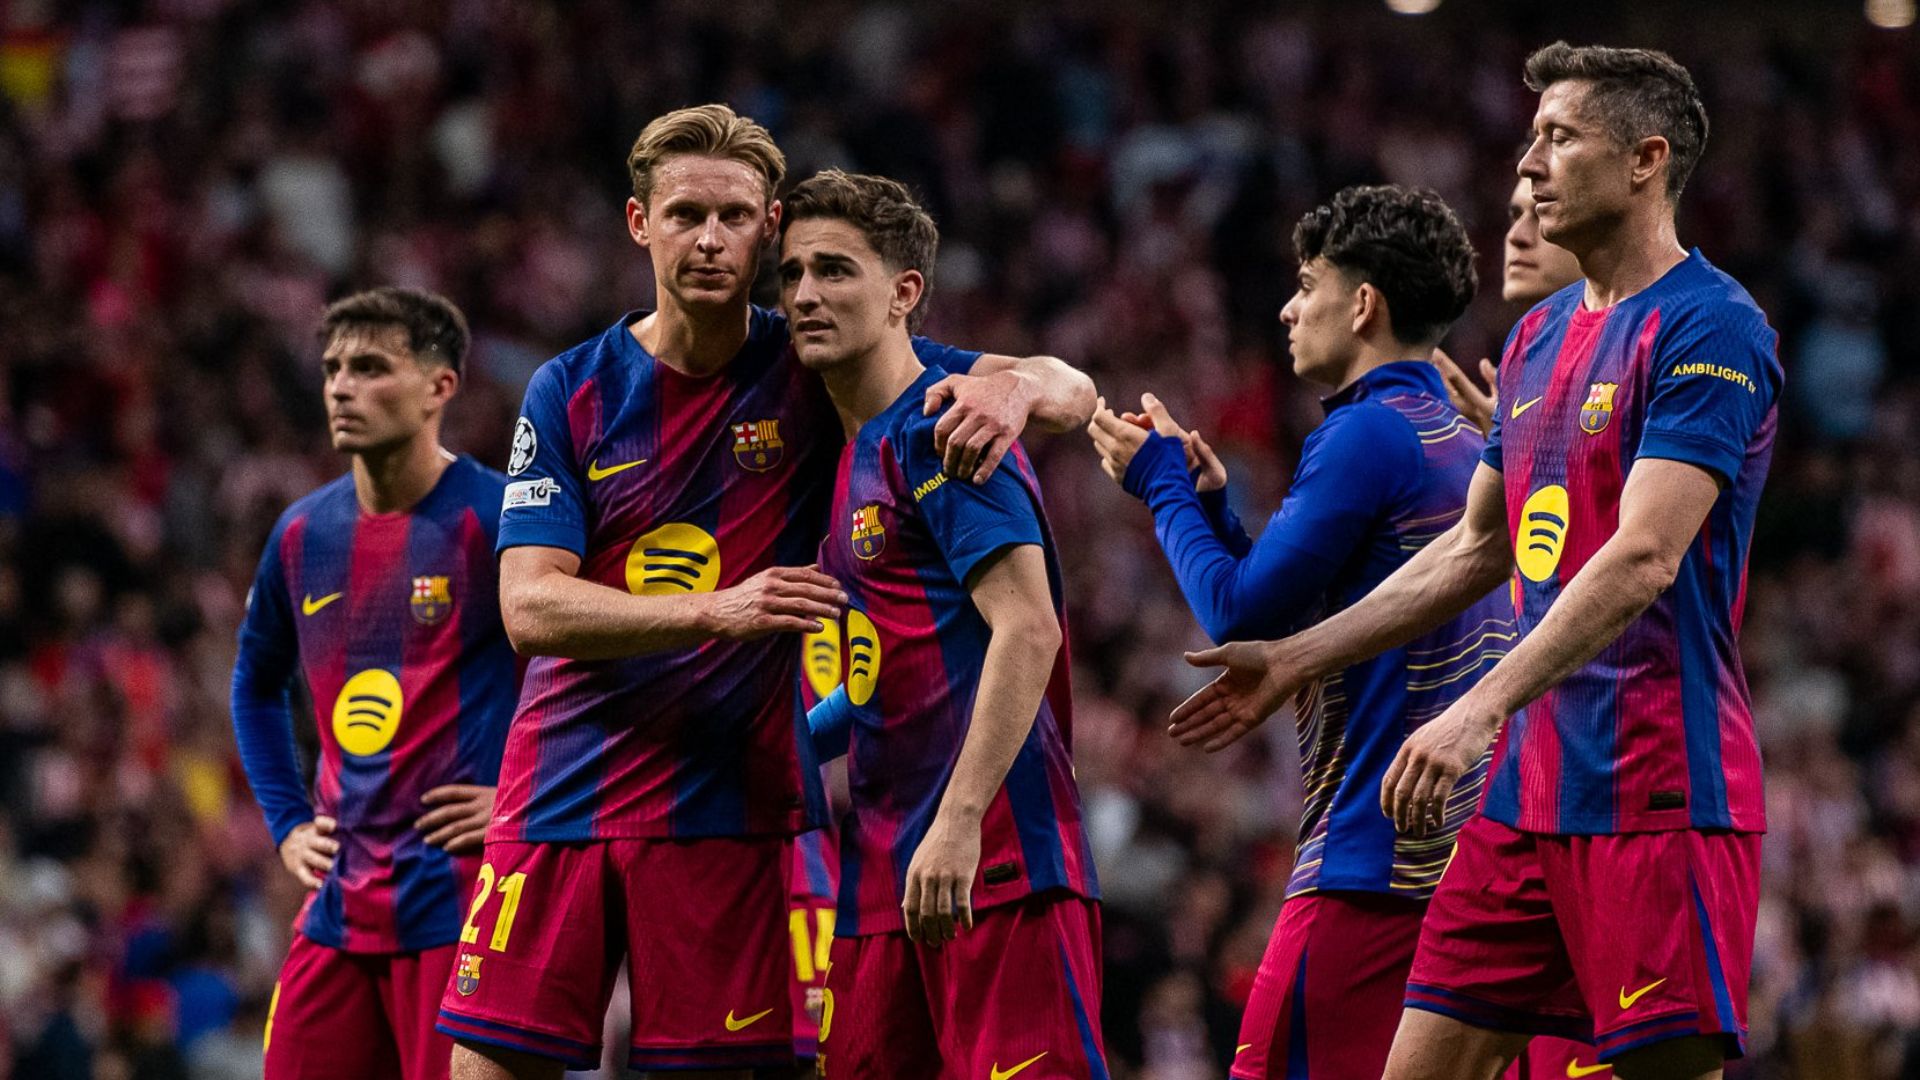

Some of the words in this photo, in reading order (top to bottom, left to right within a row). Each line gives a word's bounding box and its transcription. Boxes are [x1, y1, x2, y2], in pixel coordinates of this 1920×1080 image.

[1672, 363, 1748, 386] AMBILIGHT
[913, 472, 949, 503] AMBIL
[460, 862, 527, 952] 21
